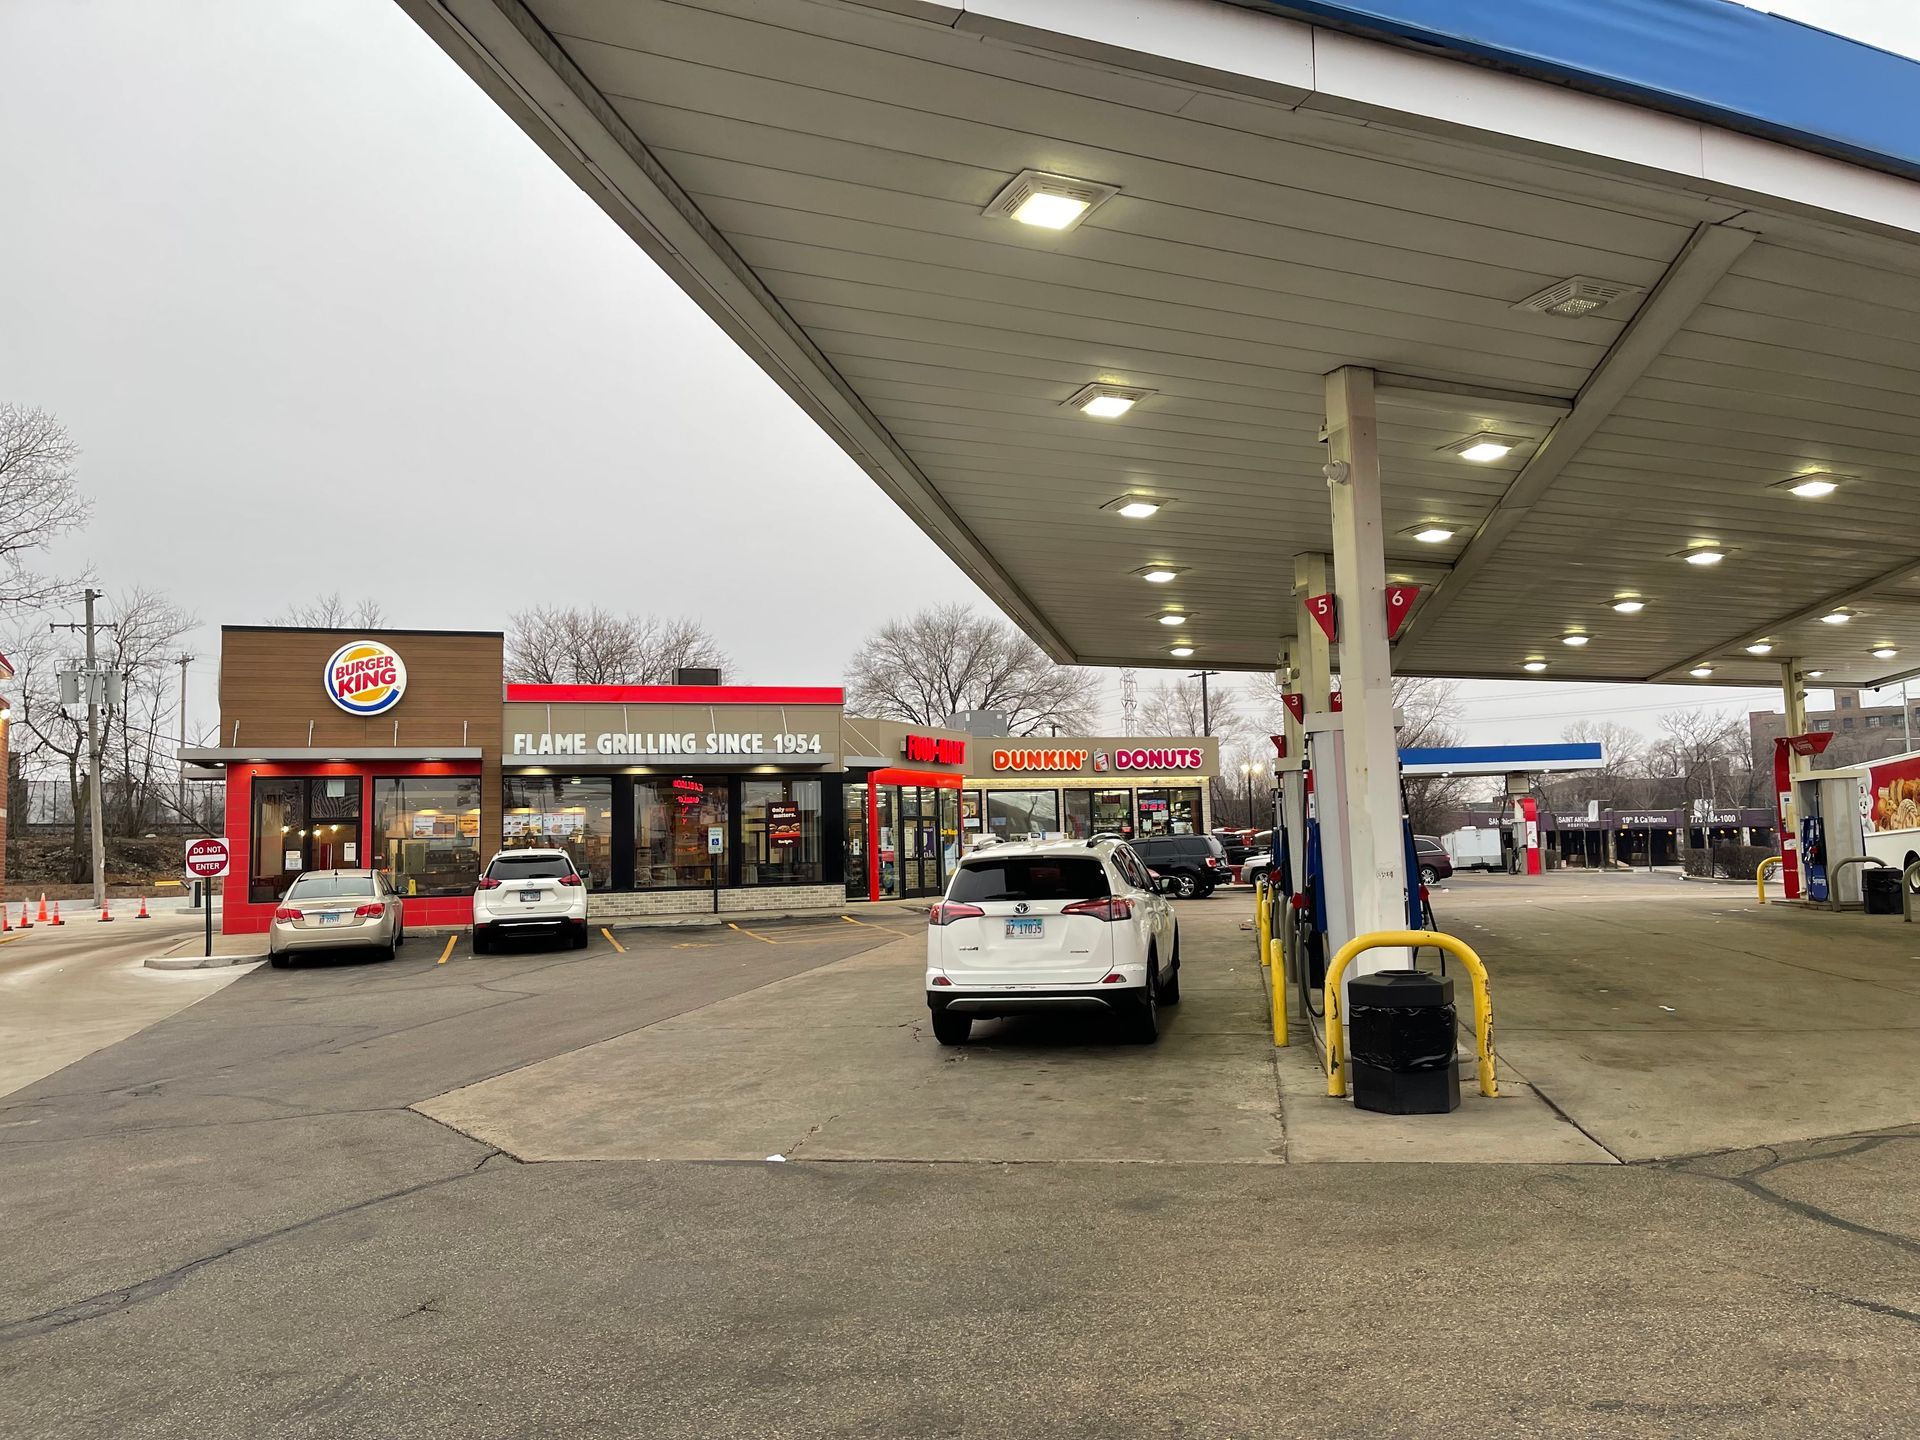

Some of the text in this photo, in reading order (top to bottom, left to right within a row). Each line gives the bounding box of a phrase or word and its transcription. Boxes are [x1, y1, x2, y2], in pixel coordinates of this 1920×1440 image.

[1391, 590, 1404, 606] 6
[1317, 598, 1328, 615] 5
[335, 655, 394, 681] BURGER
[338, 667, 397, 698] KING
[1291, 695, 1299, 706] 3
[1333, 693, 1342, 704] 4
[513, 733, 822, 755] FLAME GRILLING SINCE 1954
[993, 748, 1203, 771] DUNKIN' DONUTS
[193, 846, 222, 855] DO NOT
[195, 863, 220, 871] ENTER
